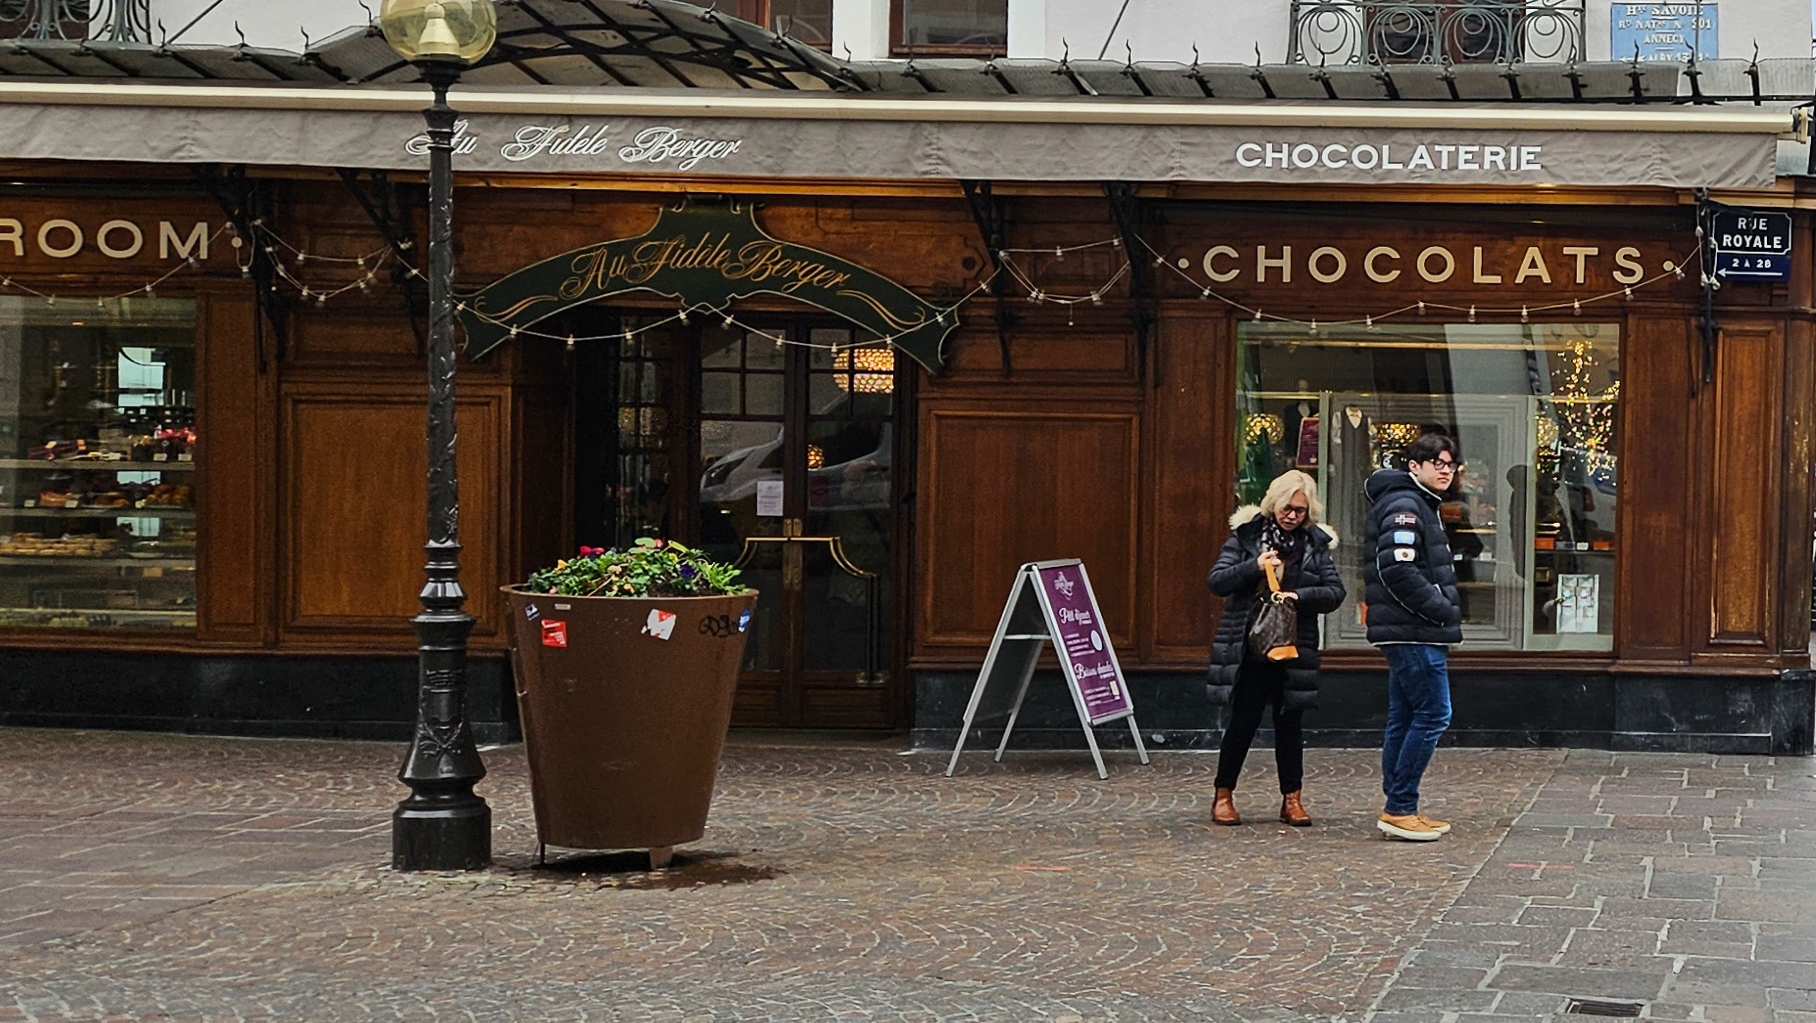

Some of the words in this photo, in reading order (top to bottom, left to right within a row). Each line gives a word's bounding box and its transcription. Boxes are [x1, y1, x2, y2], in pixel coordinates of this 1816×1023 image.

[1651, 5, 1704, 16] SAVOIE
[1643, 34, 1685, 44] ANNECY
[618, 126, 743, 171] Berger
[1236, 143, 1542, 171] CHOCOLATERIE
[1738, 218, 1768, 230] RUE
[0, 218, 209, 259] ROOM
[1722, 234, 1782, 248] ROYALE
[560, 246, 626, 300] Au
[721, 240, 851, 293] Berger
[1203, 245, 1644, 285] CHOCOLATS
[1732, 258, 1740, 267] 2
[1756, 259, 1772, 268] 28
